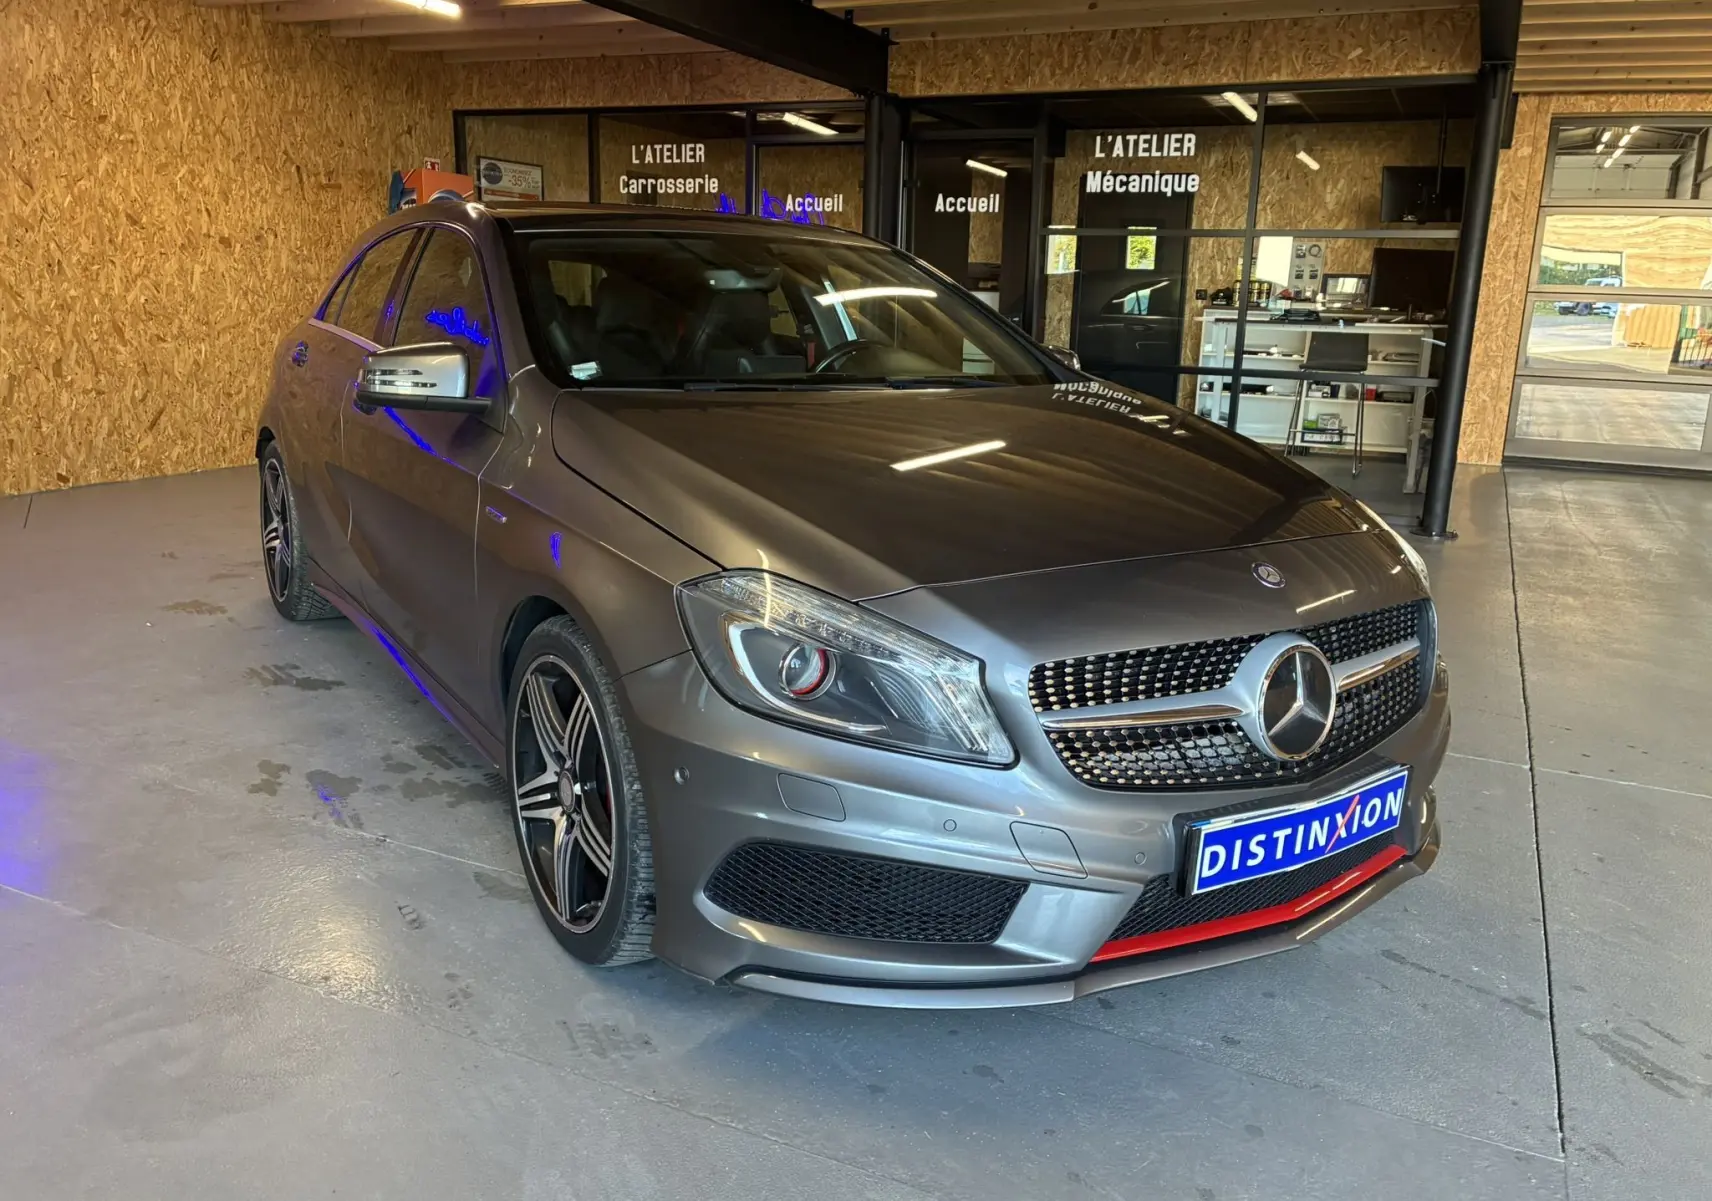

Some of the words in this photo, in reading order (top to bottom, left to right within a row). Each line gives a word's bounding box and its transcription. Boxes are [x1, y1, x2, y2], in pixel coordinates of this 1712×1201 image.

[631, 143, 706, 164] L'ATELIER
[1095, 133, 1197, 158] L'ATELIER
[619, 174, 719, 194] Carrosserie
[1086, 170, 1200, 197] Mécanique
[785, 194, 844, 213] Accueil
[934, 193, 1000, 213] Accueil
[1200, 787, 1403, 878] DISTINXION
